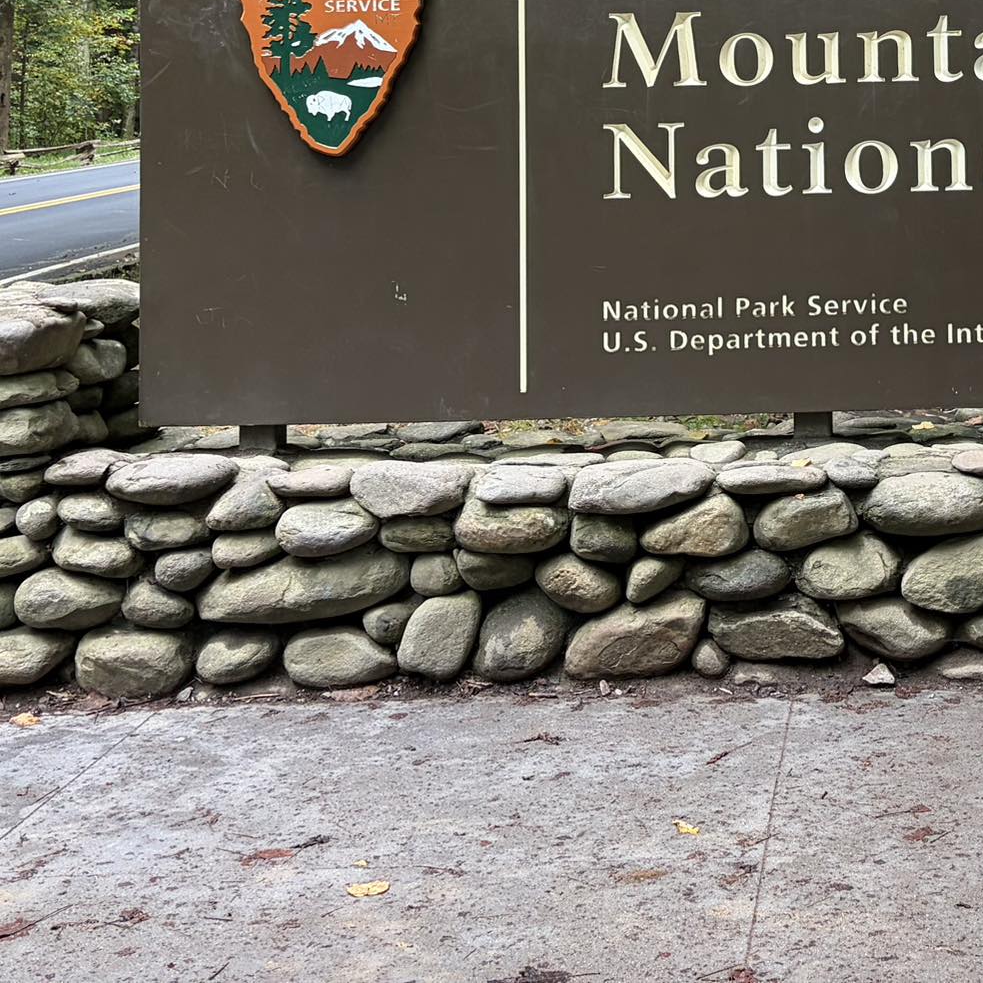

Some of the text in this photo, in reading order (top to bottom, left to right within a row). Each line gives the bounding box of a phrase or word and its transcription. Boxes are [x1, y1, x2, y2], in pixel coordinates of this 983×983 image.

[324, 0, 400, 13] SERVICE
[603, 294, 908, 322] National Park Service
[603, 331, 657, 353] U.S.
[670, 328, 840, 355] Department
[850, 323, 880, 346] of
[890, 323, 935, 345] the
